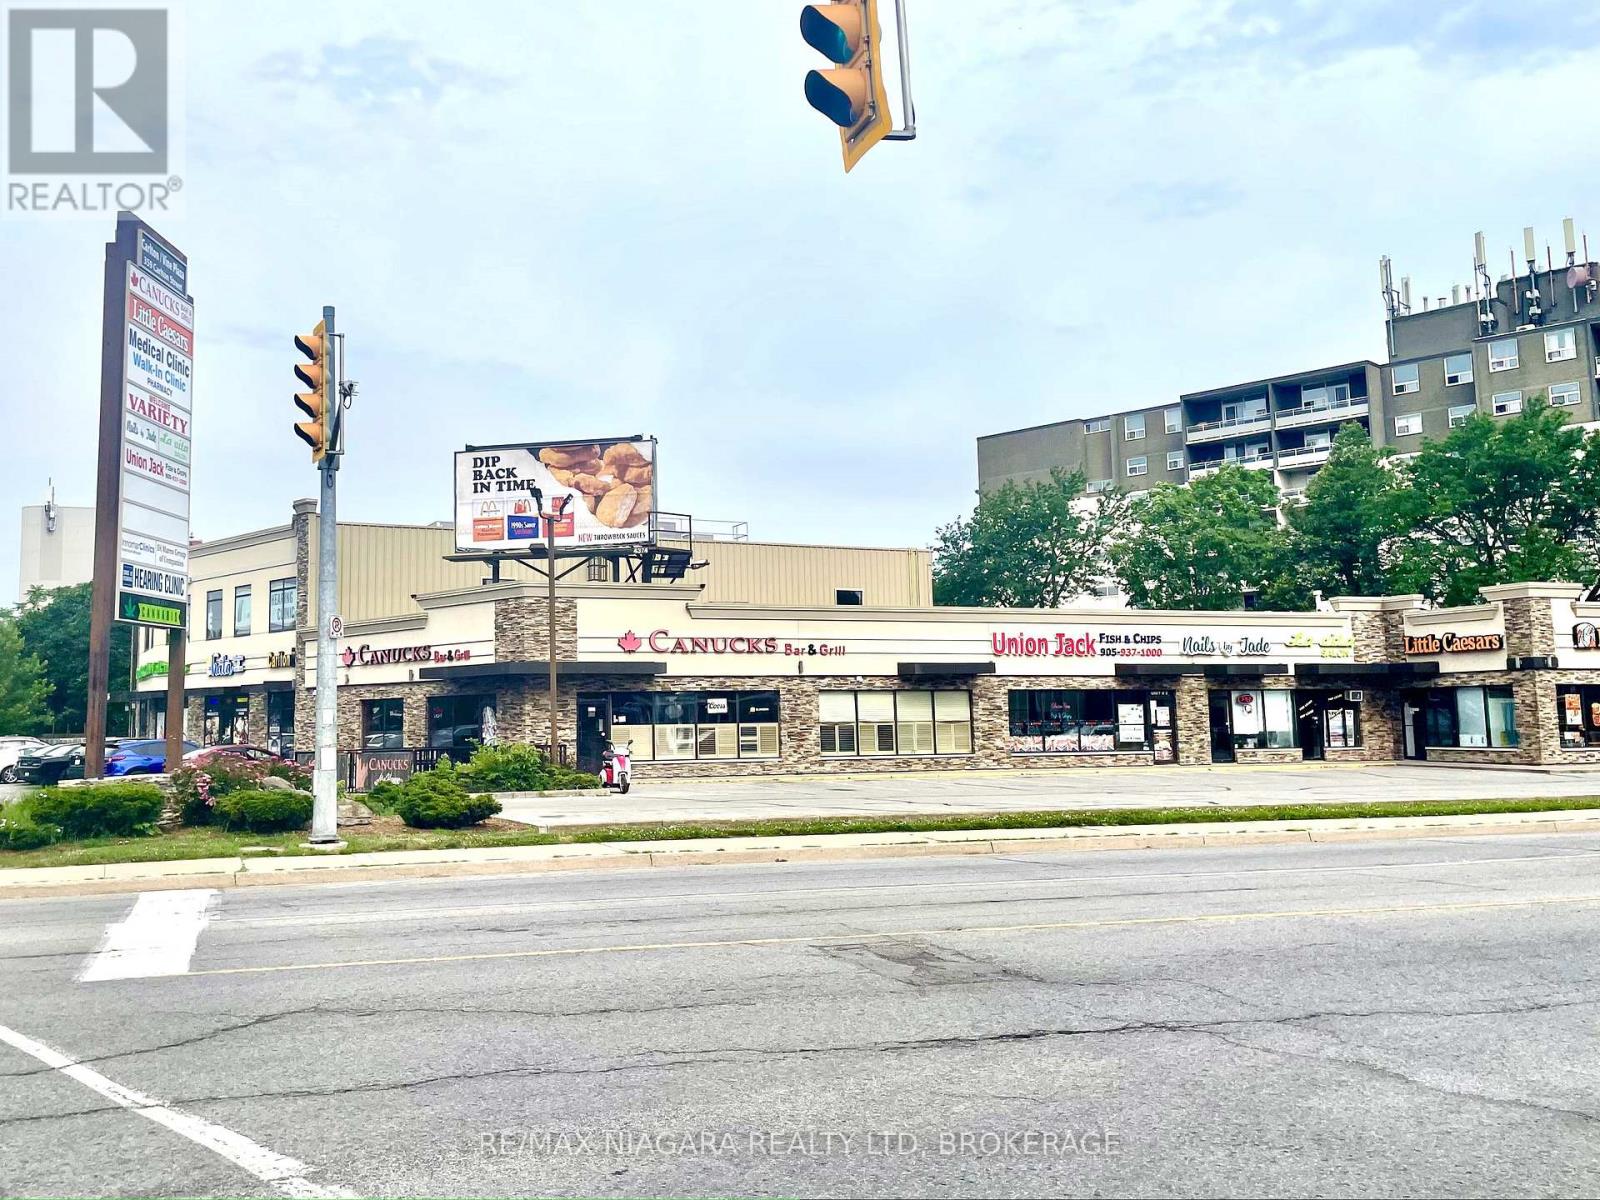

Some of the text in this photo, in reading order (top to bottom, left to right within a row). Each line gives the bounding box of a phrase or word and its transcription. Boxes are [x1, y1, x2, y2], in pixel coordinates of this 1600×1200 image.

[139, 276, 181, 317] CANUCKS
[132, 298, 157, 333] Little
[129, 328, 190, 379] Medical Clinic
[165, 370, 186, 392] Clinic
[128, 393, 188, 435] VARIETY
[126, 448, 164, 477] Union Jack
[472, 455, 501, 469] DIP
[472, 467, 518, 482] BACK
[472, 479, 536, 494] IN TIME
[578, 533, 593, 543] NEW
[627, 532, 646, 540] SAUCES
[134, 567, 185, 597] HEARING CLINIC
[649, 629, 846, 657] CANUCKS Bar & Grill
[992, 632, 1097, 658] Union Jack
[1124, 634, 1131, 644] &
[1183, 636, 1271, 654] Nails by Jade
[1404, 632, 1501, 654] Little Caesars
[359, 644, 470, 667] CANUCKS Bar & Grill
[1100, 648, 1163, 659] 905-937-1000
[369, 758, 409, 771] CANUCKS
